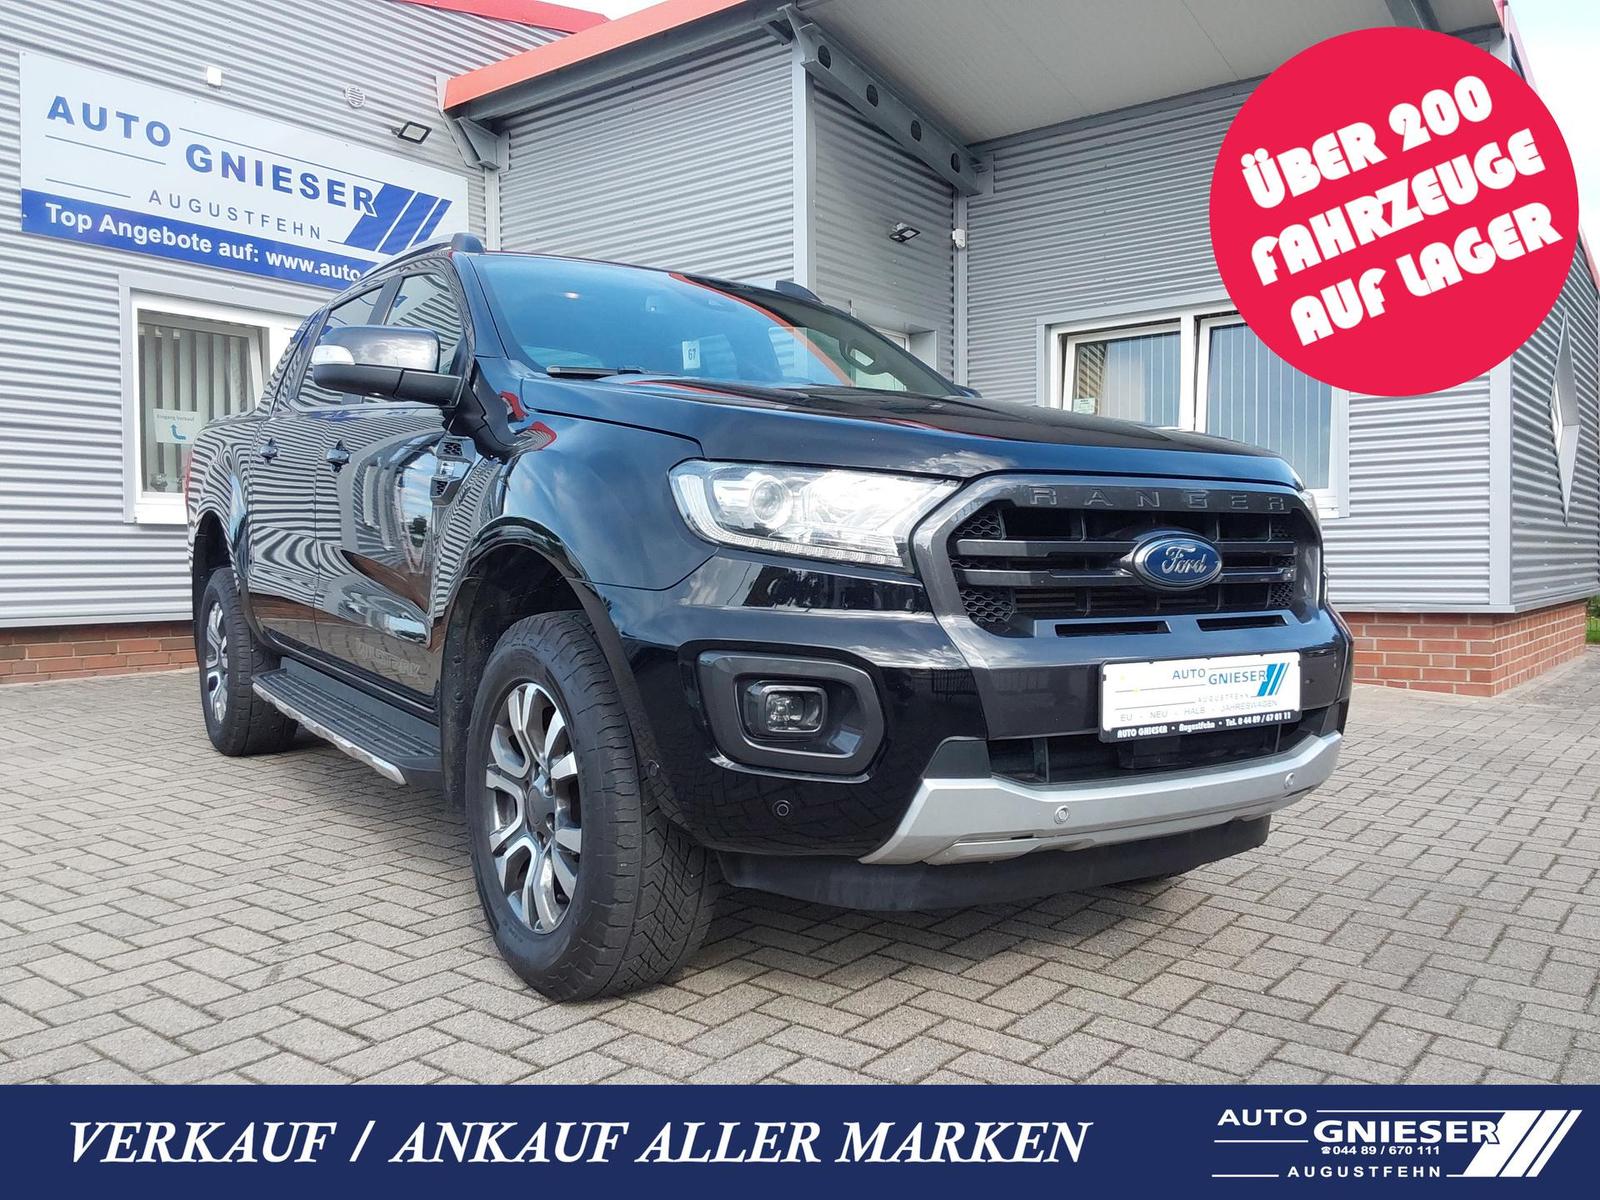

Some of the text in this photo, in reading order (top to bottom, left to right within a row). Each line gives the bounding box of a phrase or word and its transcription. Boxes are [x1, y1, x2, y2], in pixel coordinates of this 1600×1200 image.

[47, 95, 171, 148] AUTO
[186, 143, 375, 215] GNIESER
[148, 190, 320, 240] AUGUSTFEHN
[45, 202, 93, 233] Top
[98, 214, 213, 254] Angebote
[218, 242, 259, 263] auf:
[1029, 486, 1286, 511] RANGER
[1161, 546, 1207, 574] Ford
[1172, 668, 1206, 680] AUTO
[1208, 670, 1267, 685] GNIESER
[1120, 713, 1133, 722] EU
[1150, 710, 1168, 719] NEU
[1184, 706, 1206, 715] HALB
[1117, 728, 1137, 738] AUTO
[1138, 725, 1168, 736] GNIESER
